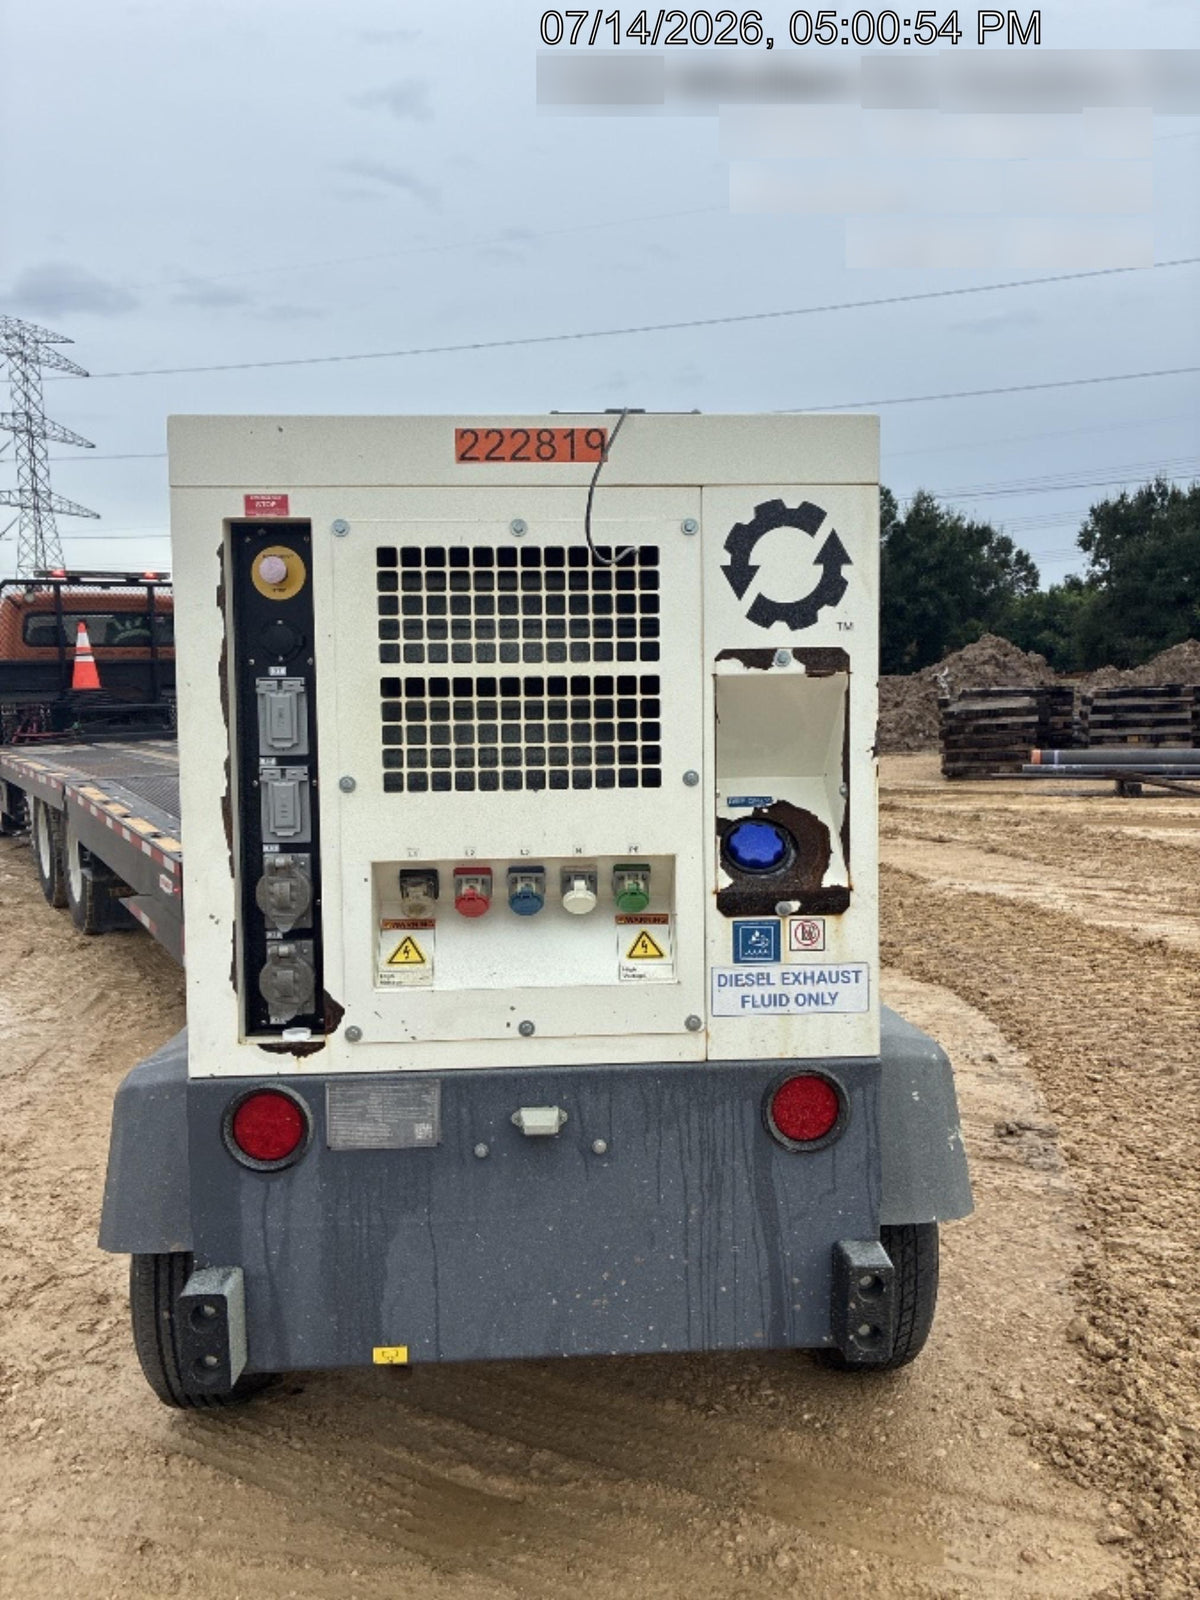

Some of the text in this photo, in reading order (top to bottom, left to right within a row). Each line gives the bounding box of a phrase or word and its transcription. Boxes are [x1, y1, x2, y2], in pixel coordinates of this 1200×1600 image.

[458, 428, 606, 461] 222819
[836, 621, 854, 632] TM
[717, 970, 863, 988] DIESEL EXHAUST
[740, 992, 839, 1009] FLUID ONLY
